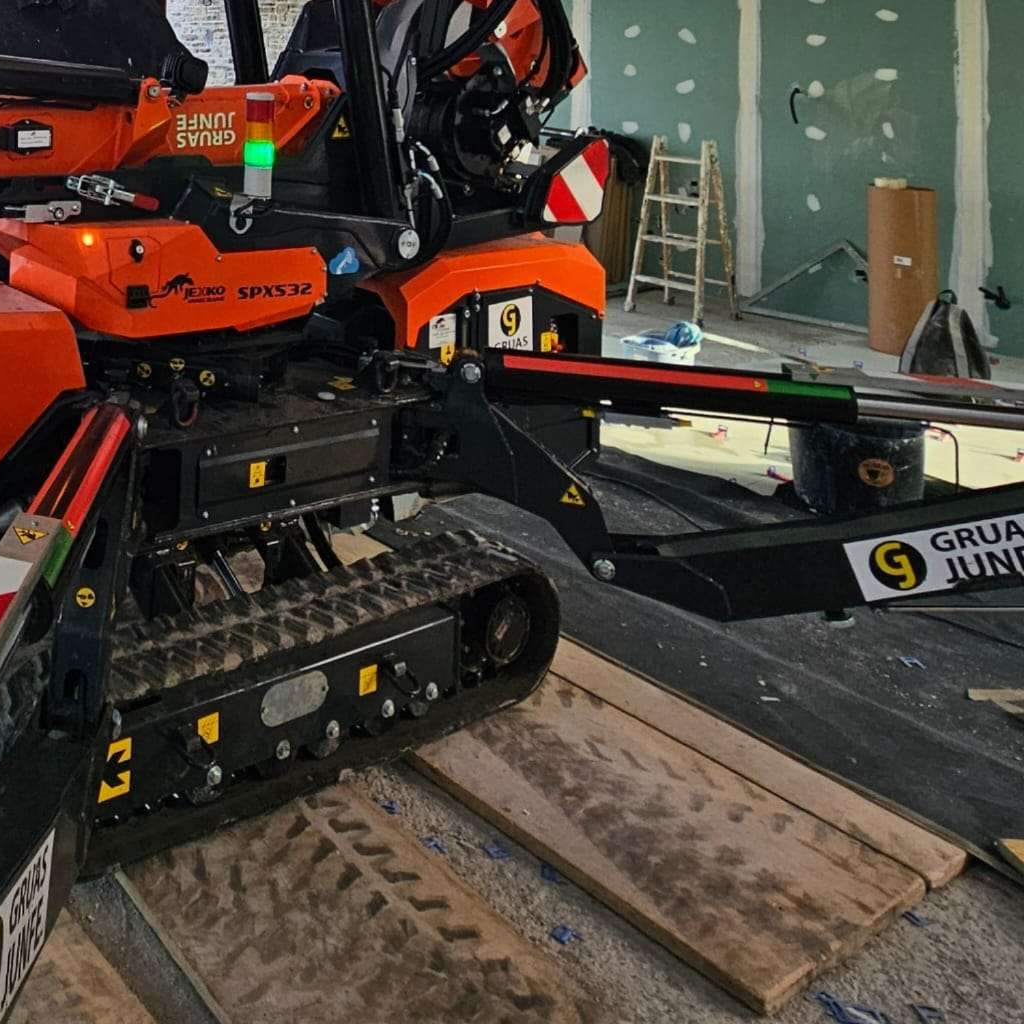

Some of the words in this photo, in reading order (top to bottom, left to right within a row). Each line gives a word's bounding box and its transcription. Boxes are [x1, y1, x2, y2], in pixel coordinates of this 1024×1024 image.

[176, 111, 236, 131] JUNFE
[176, 130, 236, 148] GRUAS
[237, 283, 313, 299] SPX532
[9, 844, 49, 934] GRUAS
[0, 895, 45, 1010] JUNFE
